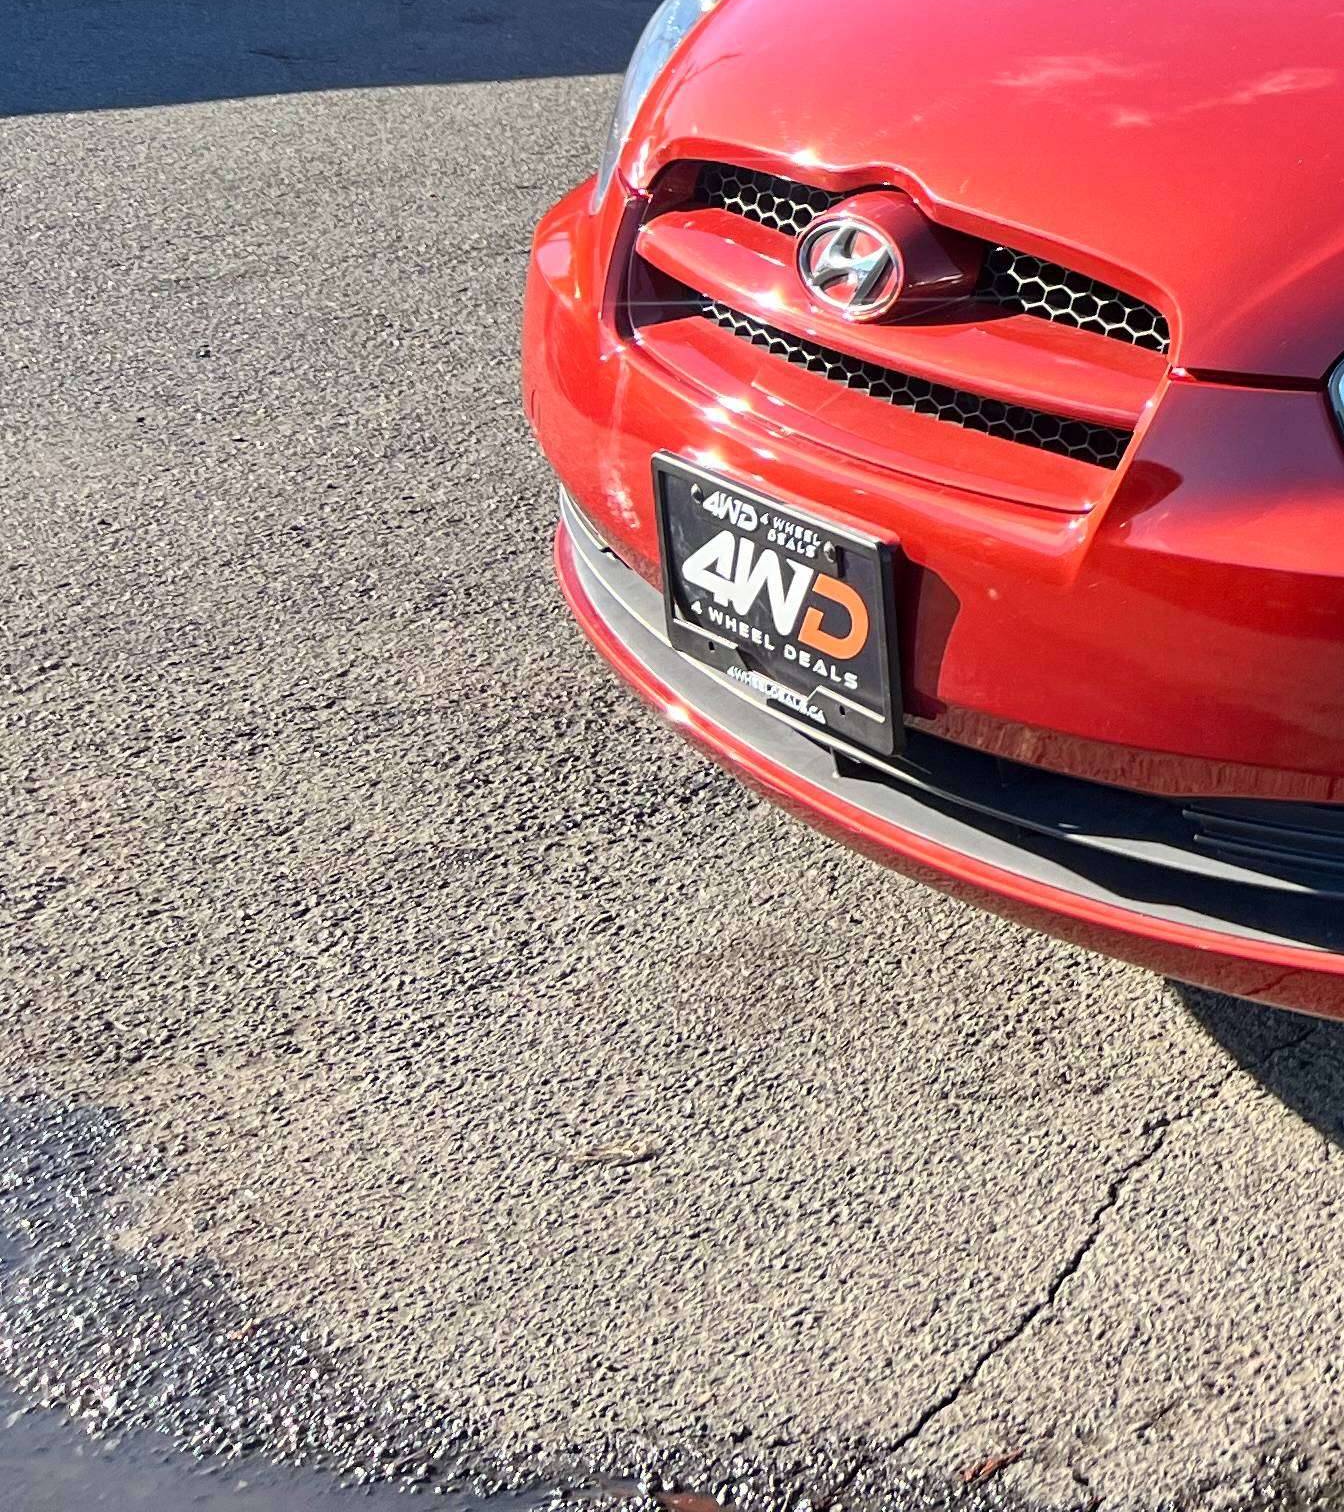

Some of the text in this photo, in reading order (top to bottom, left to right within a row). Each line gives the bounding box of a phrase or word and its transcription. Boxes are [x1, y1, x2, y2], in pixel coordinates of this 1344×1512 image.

[702, 490, 758, 531] 4WD
[760, 512, 820, 547] 4 WHEEL
[767, 528, 816, 558] DEALS
[681, 530, 869, 660] 4WD
[690, 599, 858, 690] 4 WHEEL DEALS
